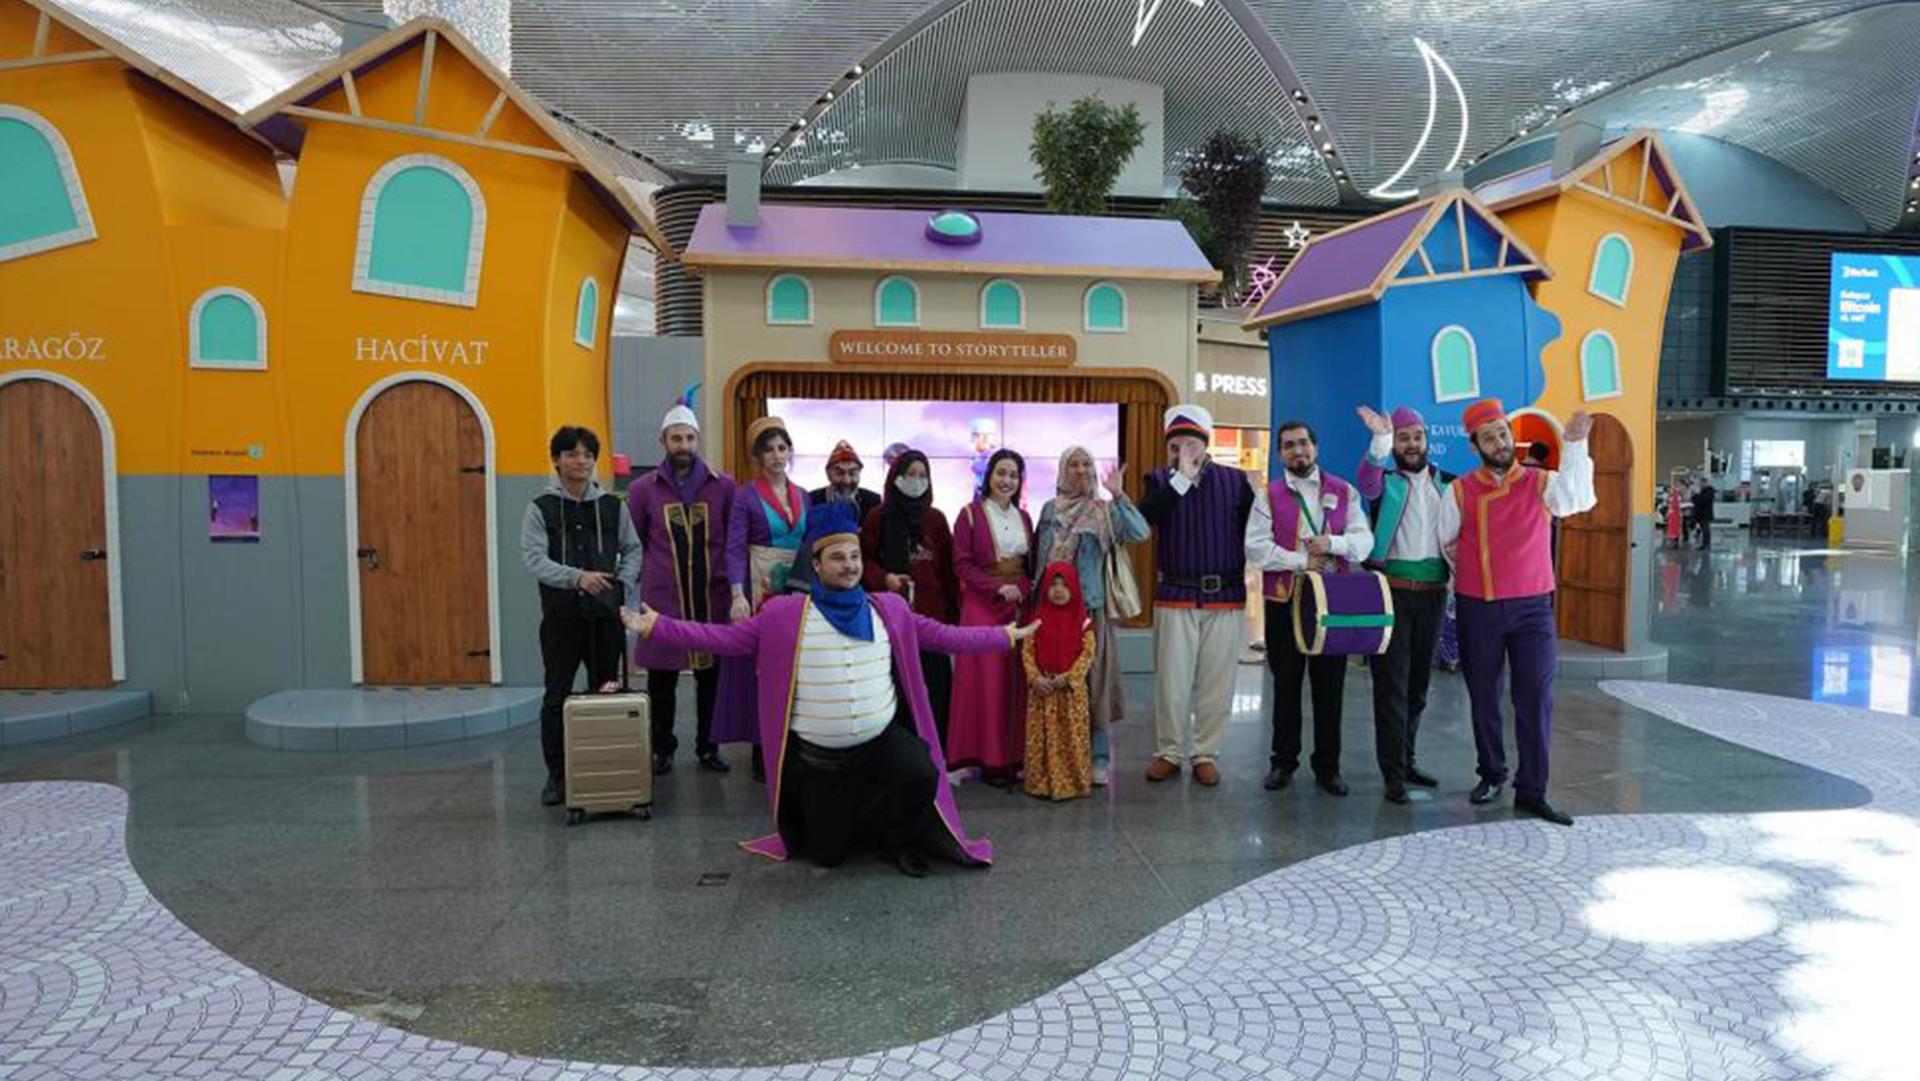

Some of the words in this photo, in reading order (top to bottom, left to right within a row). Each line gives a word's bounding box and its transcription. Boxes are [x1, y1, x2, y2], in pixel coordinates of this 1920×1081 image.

[0, 331, 104, 360] RAGÖZ
[355, 334, 488, 365] HACİVAT
[841, 341, 922, 355] WELCOME
[928, 343, 951, 356] TO
[955, 343, 1067, 358] STORYTELLER
[1211, 373, 1267, 396] PRESS
